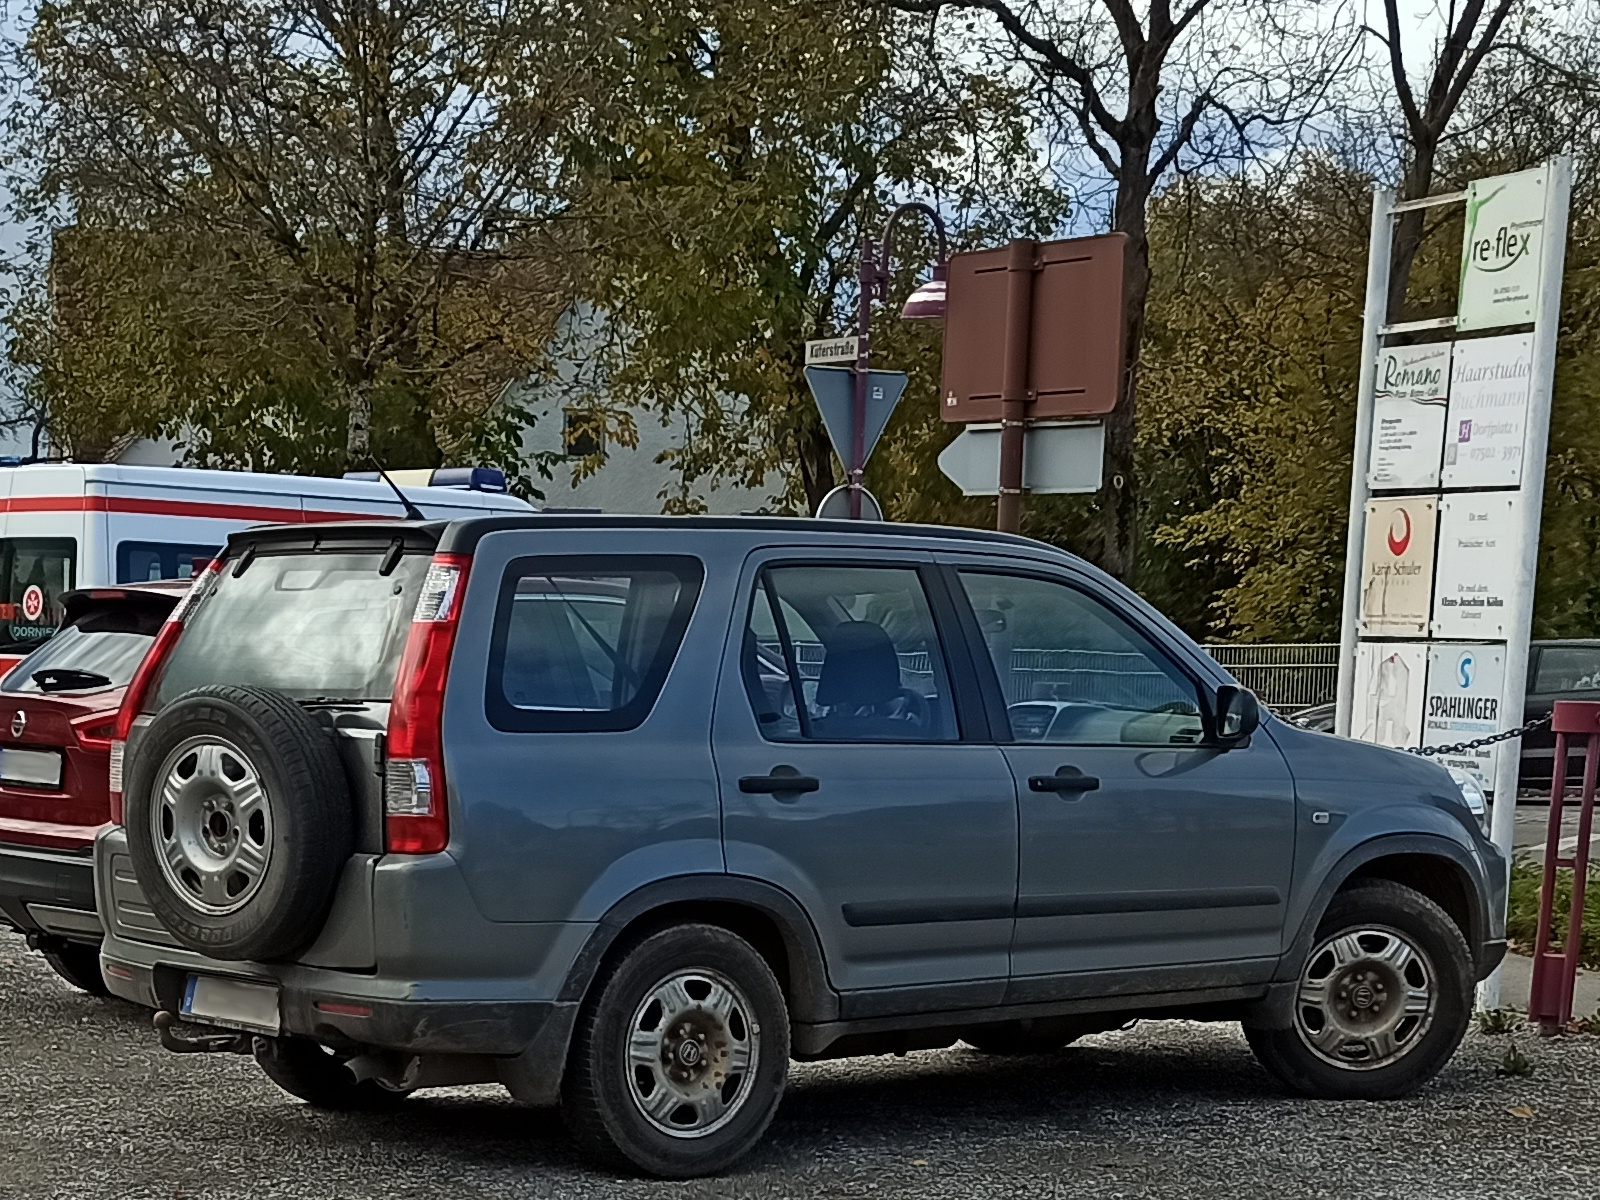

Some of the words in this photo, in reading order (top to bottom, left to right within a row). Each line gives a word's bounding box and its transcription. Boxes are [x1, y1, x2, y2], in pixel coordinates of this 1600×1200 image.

[1384, 354, 1442, 390] Romano
[1452, 355, 1531, 384] Haarstudio
[1452, 385, 1525, 411] Buchmann
[1428, 695, 1498, 720] SPAHLINGER
